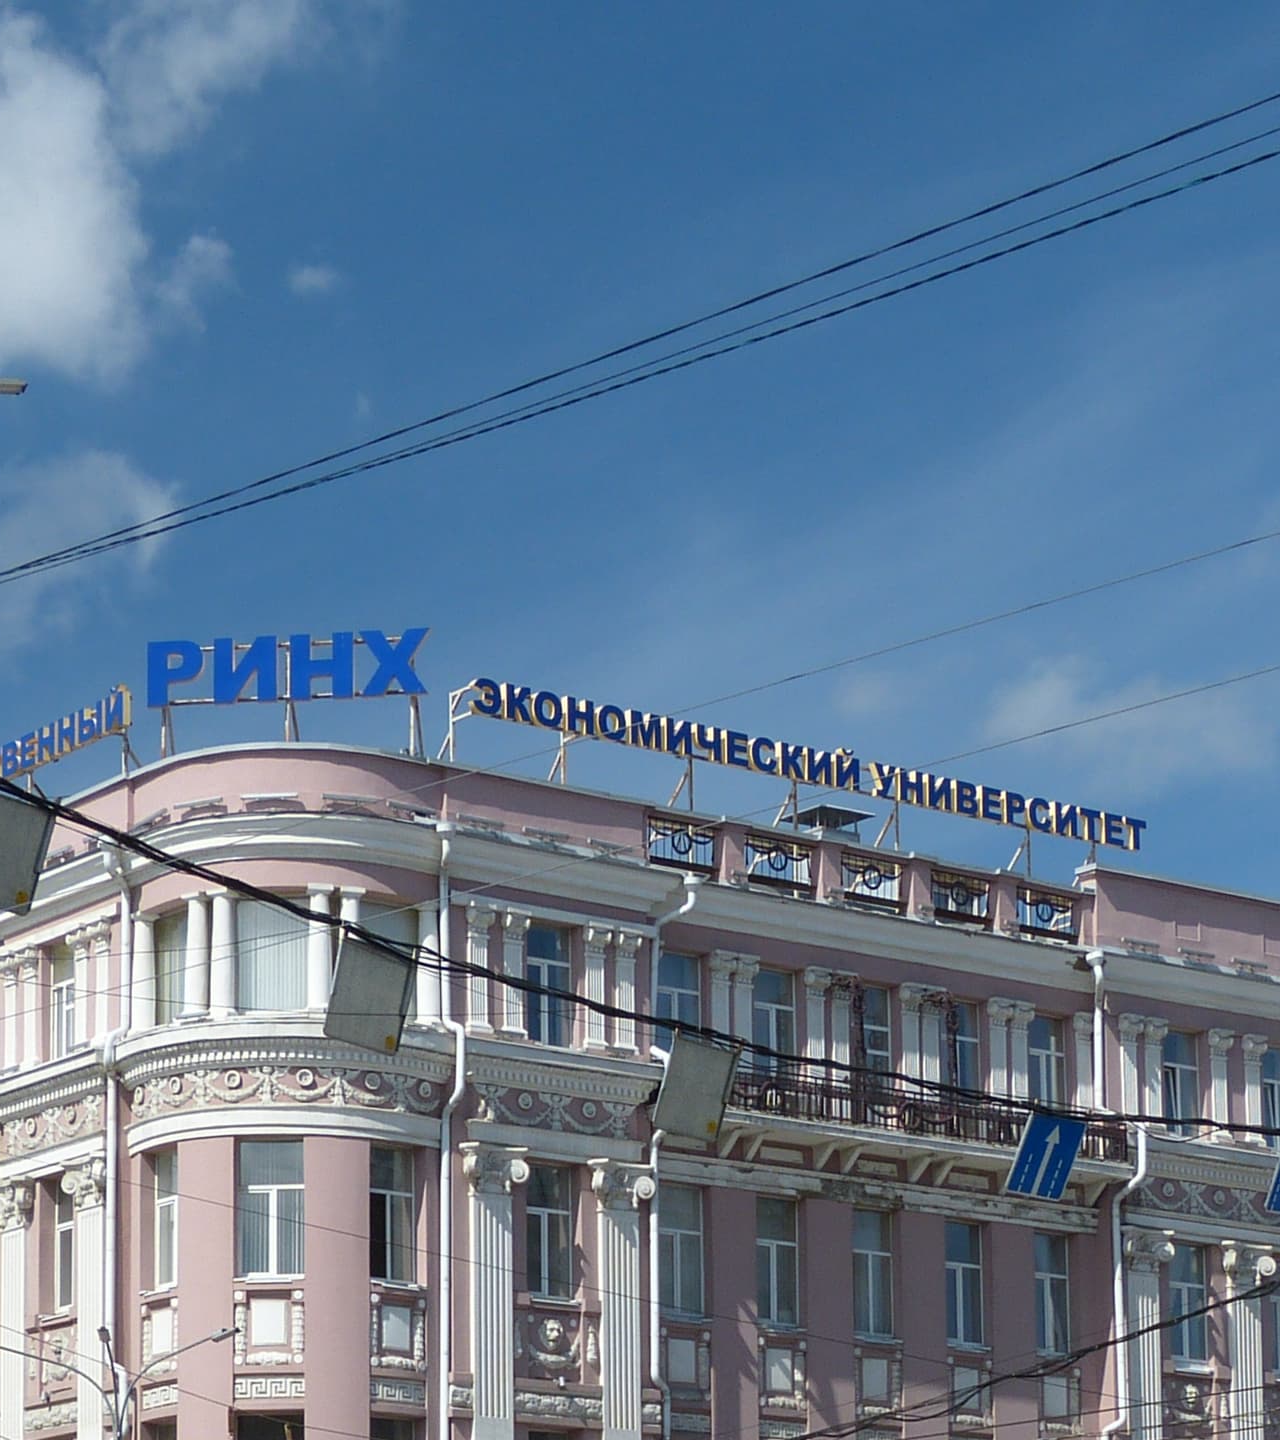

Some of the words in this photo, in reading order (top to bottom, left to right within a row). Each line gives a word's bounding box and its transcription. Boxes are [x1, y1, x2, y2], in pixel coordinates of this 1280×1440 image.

[147, 627, 429, 707] РИНХ
[470, 678, 860, 792] ЭКОНОМИЧЕСКИЙ
[871, 762, 1147, 850] УНИВЕРСИТЕТ
